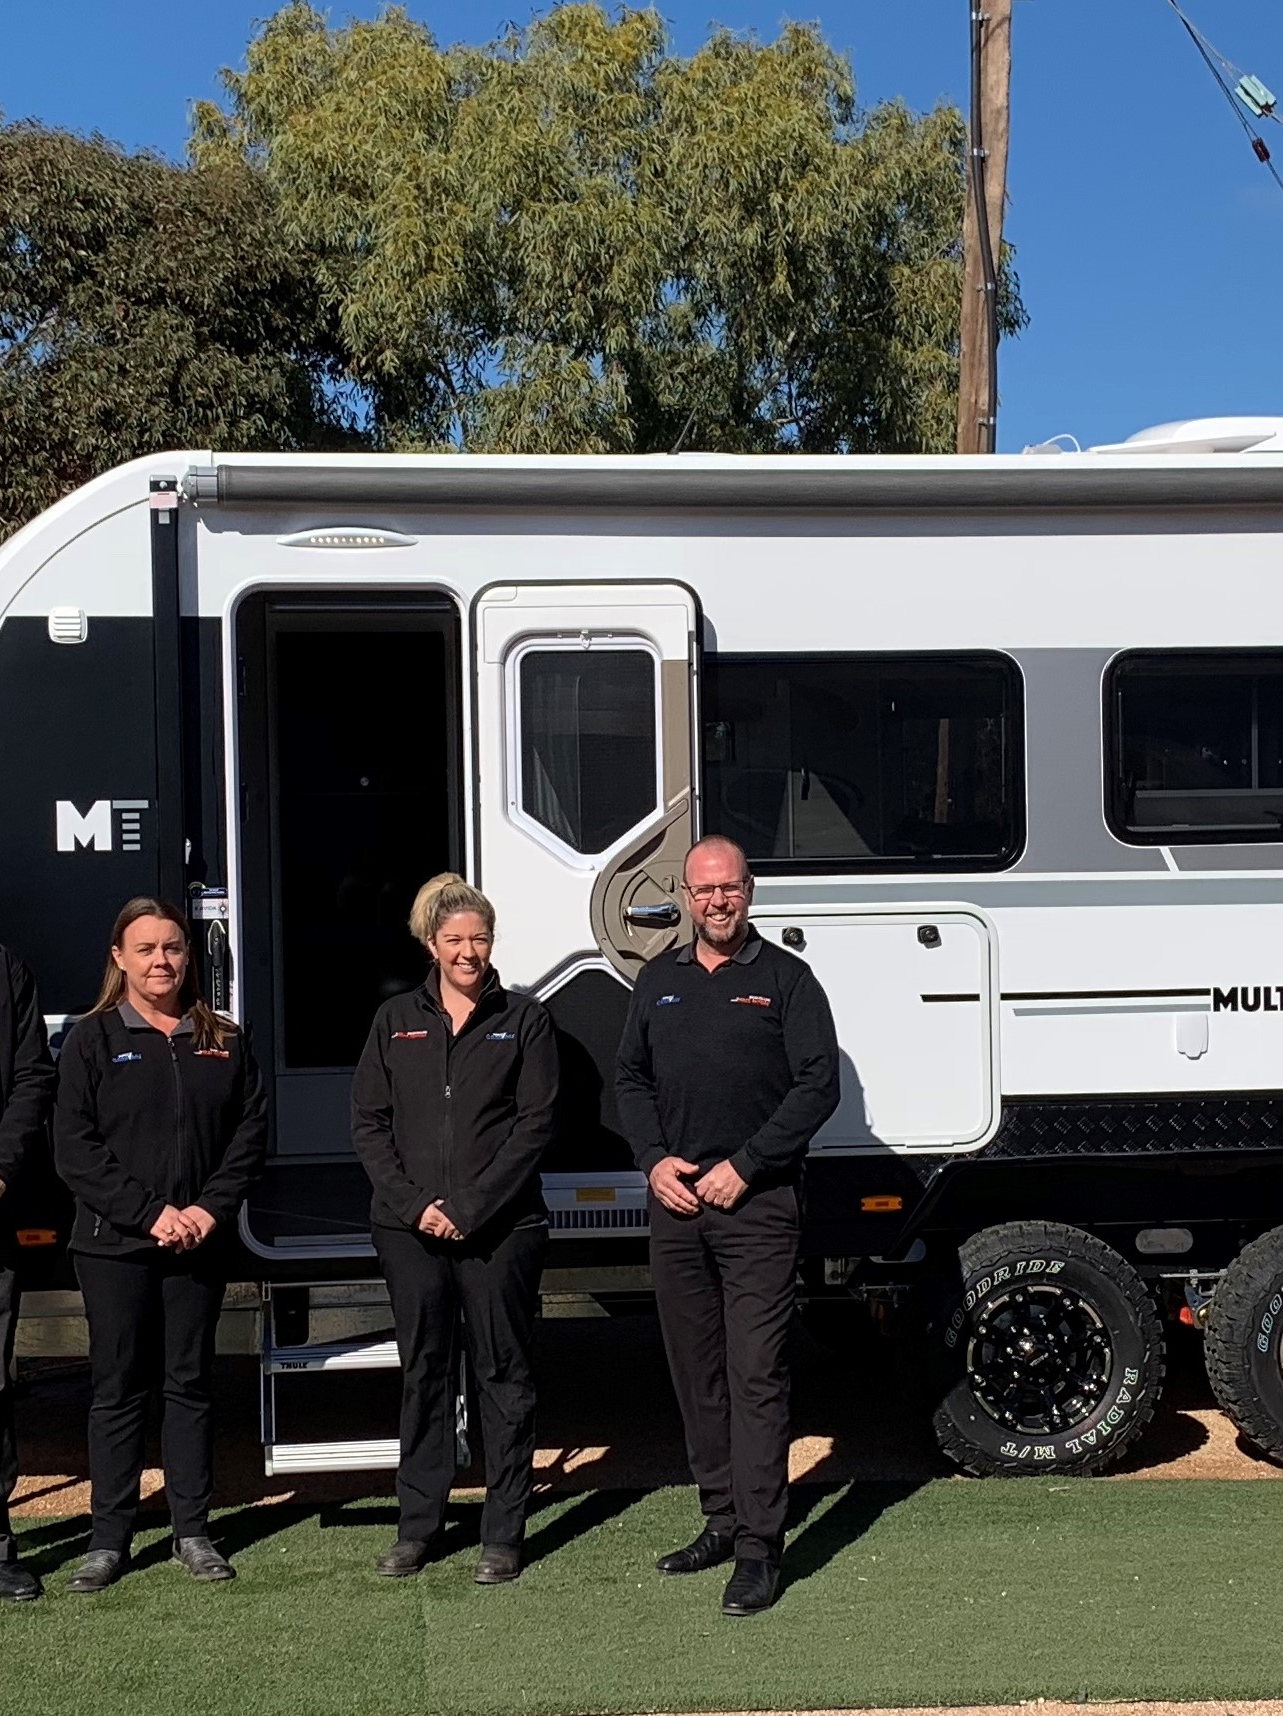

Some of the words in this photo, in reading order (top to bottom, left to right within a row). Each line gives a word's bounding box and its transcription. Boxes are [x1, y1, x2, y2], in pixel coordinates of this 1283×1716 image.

[945, 1259, 1066, 1348] GOODRIDE
[279, 1361, 309, 1370] THULE
[1065, 1367, 1139, 1454] RADIAL
[1000, 1441, 1057, 1460] M/T
